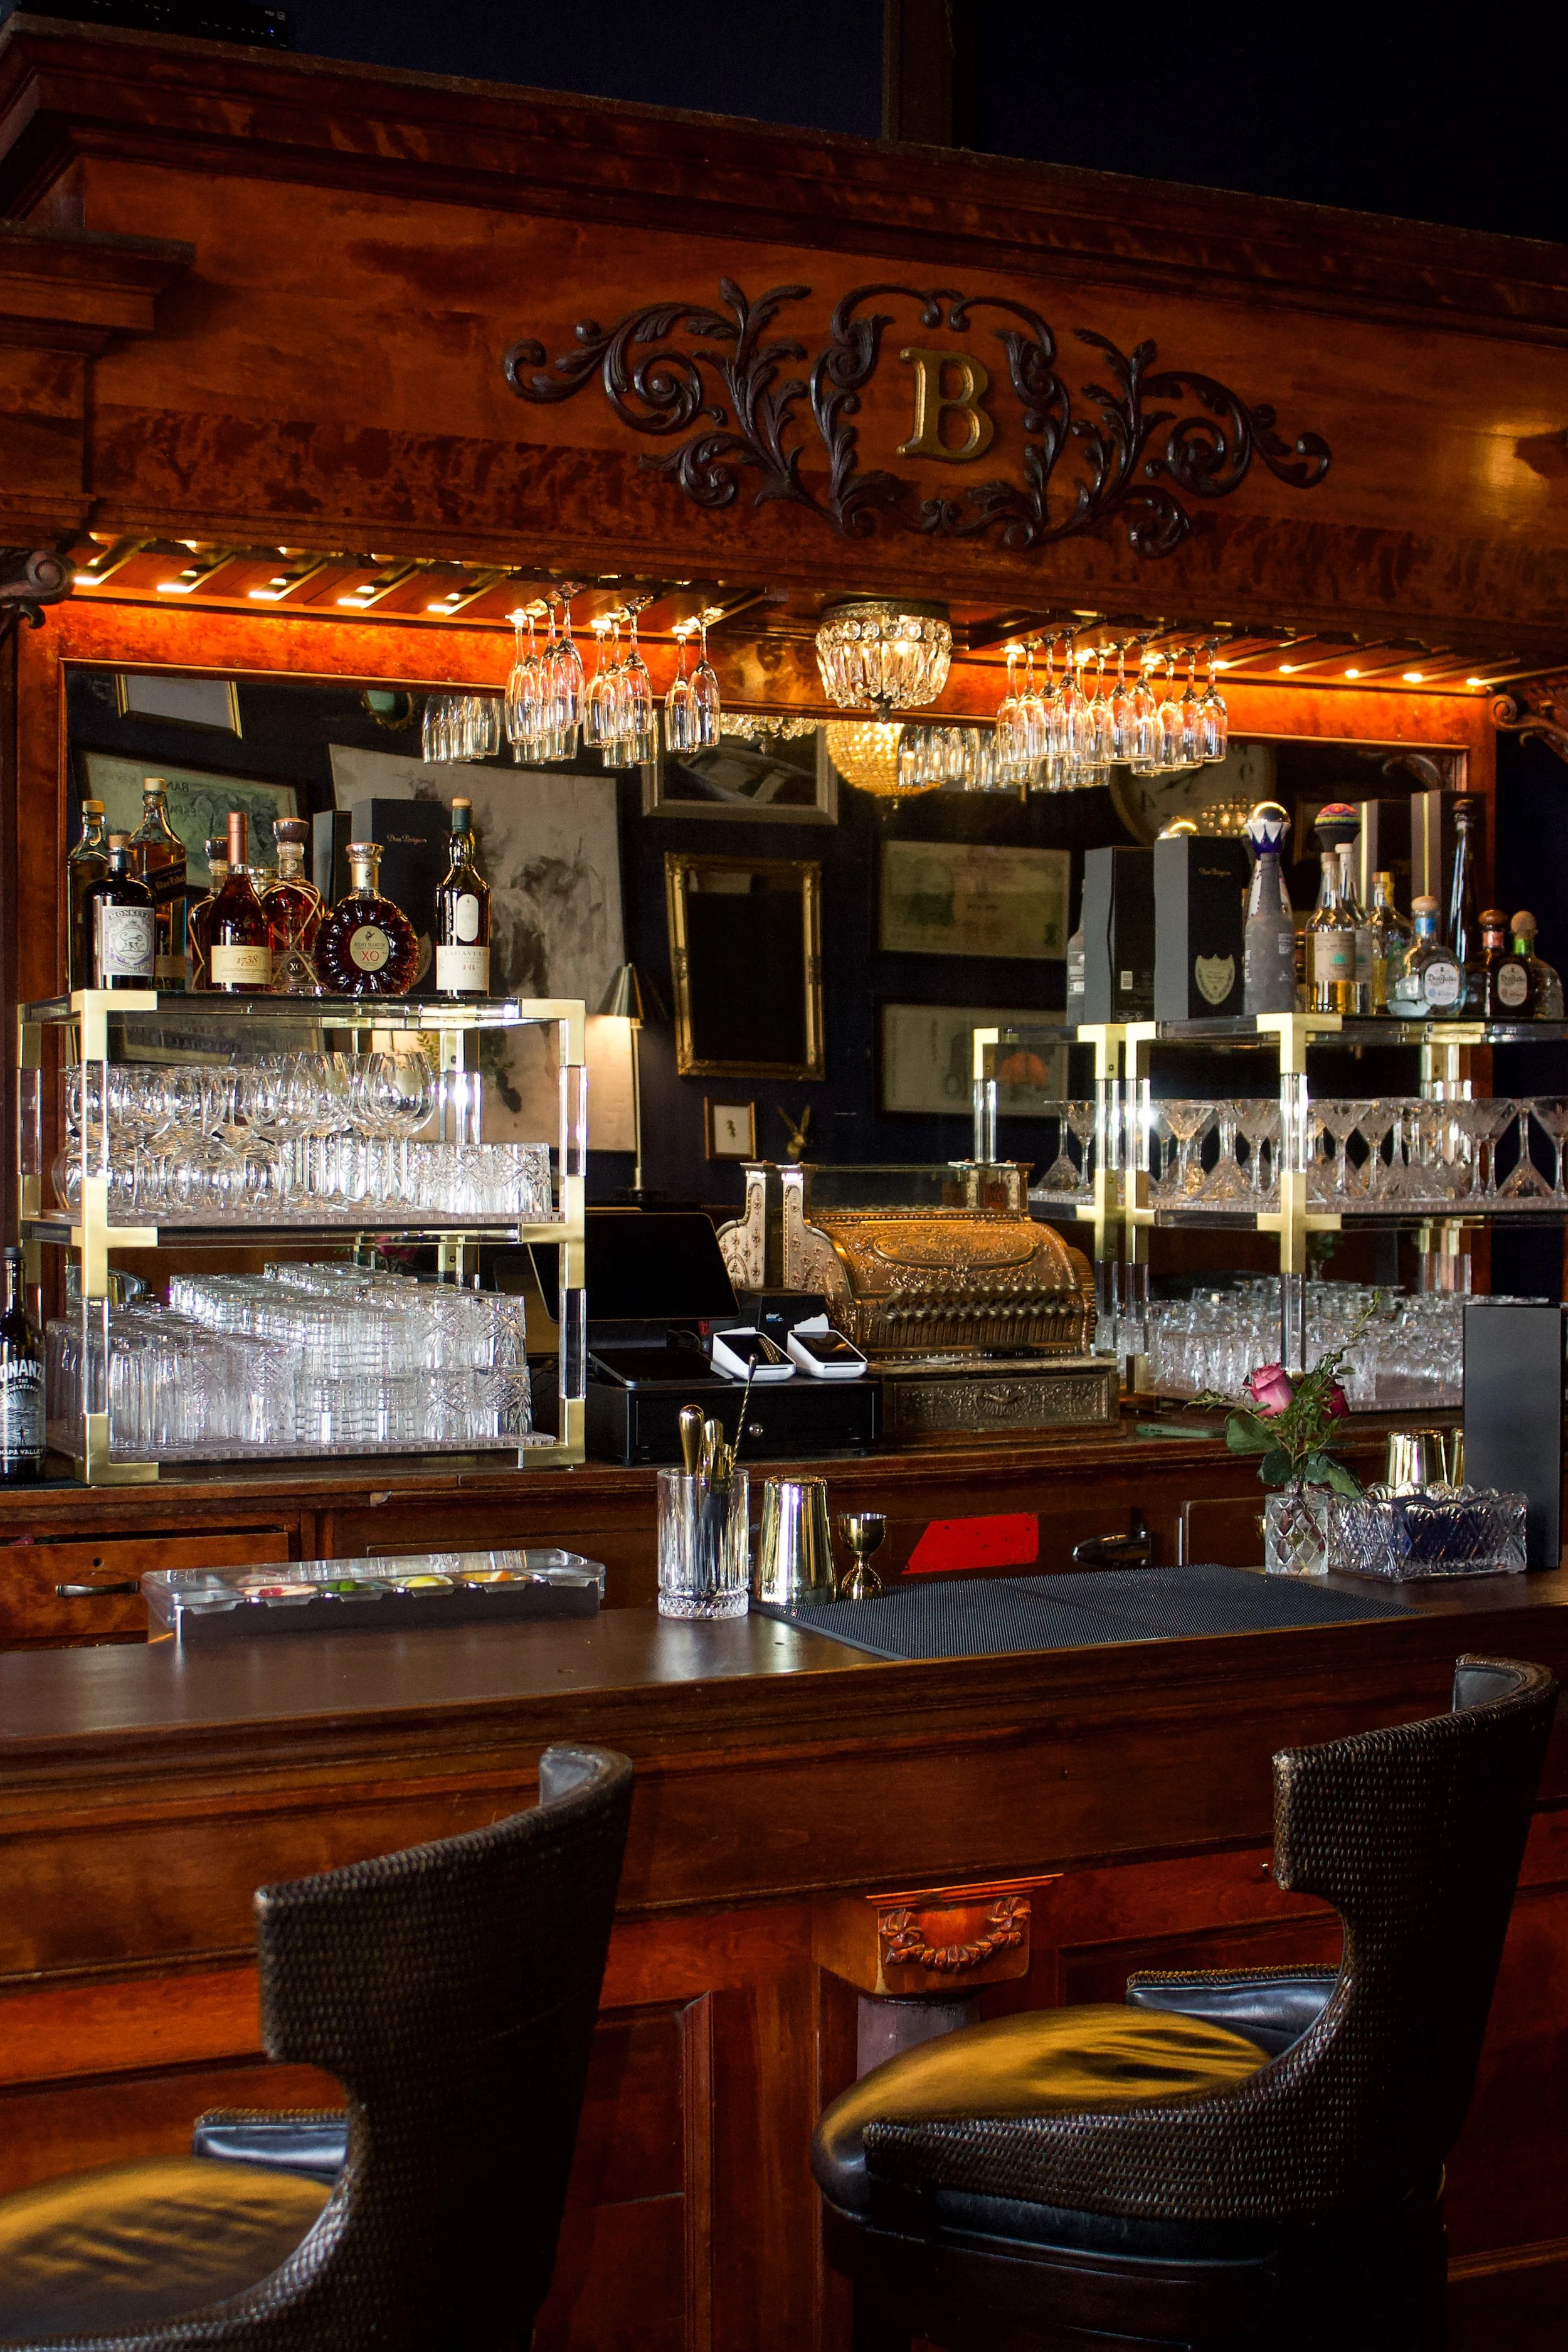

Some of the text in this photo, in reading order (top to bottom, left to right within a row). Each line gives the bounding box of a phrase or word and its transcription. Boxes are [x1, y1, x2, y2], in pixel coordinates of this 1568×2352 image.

[896, 347, 993, 459] B
[236, 955, 258, 967] 1738
[361, 951, 379, 961] XO
[290, 962, 302, 971] XO
[0, 1359, 43, 1382] ONANZ
